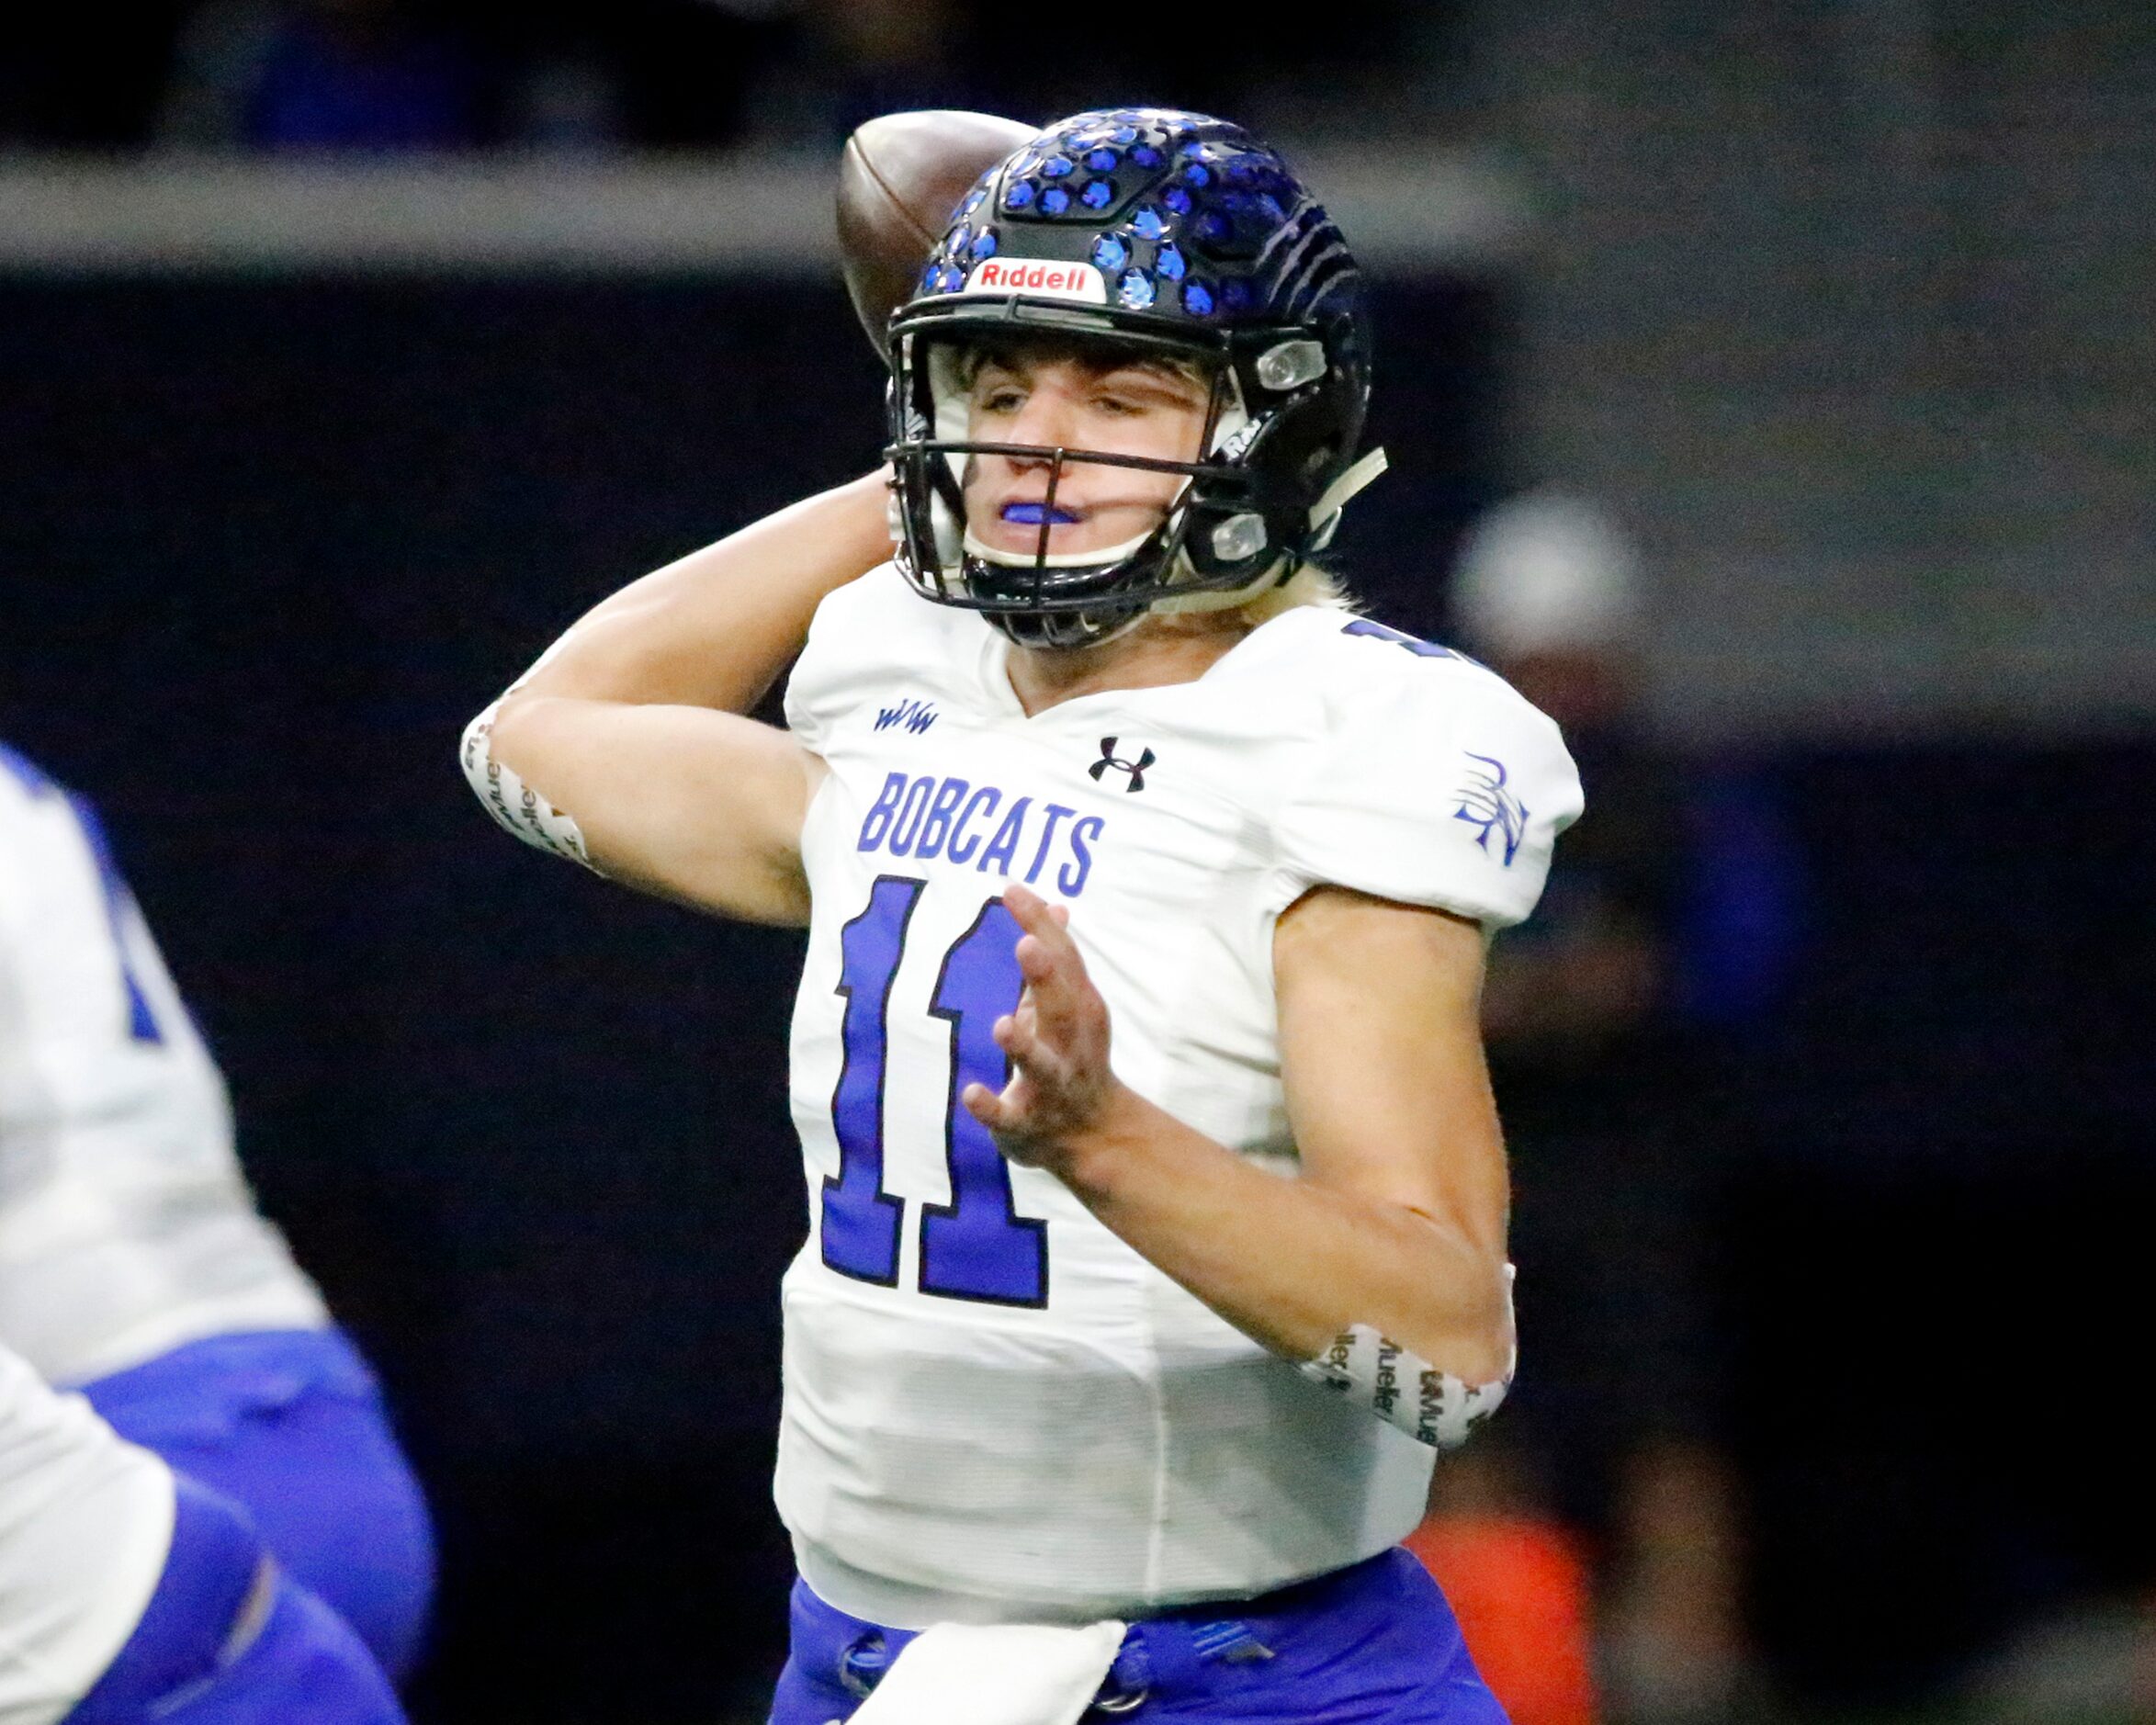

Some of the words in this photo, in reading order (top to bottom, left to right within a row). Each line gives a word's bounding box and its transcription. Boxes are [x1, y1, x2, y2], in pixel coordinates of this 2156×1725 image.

[980, 264, 1088, 291] Riddell
[857, 772, 1106, 898] BOBCATS
[821, 874, 1049, 1311] 11
